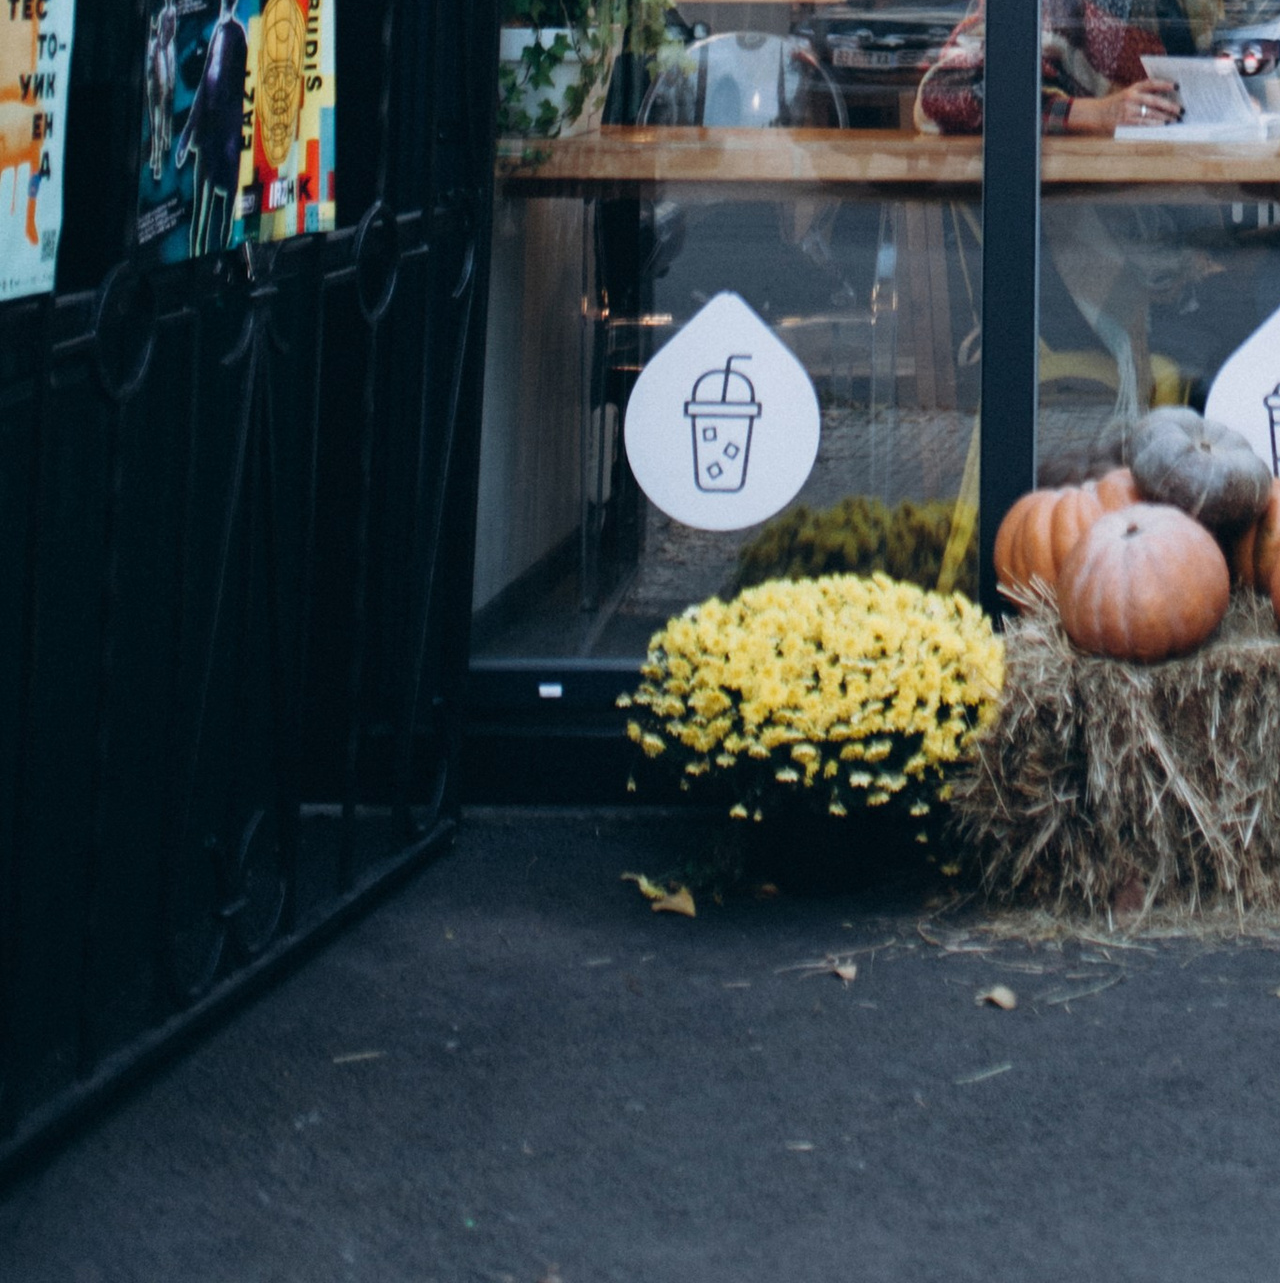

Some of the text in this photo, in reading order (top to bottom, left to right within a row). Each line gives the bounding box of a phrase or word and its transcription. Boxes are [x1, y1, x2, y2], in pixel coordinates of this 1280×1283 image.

[37, 33, 67, 60] ТО-
[20, 73, 56, 102] УИК
[32, 112, 54, 140] ЕН
[40, 151, 51, 181] Д
